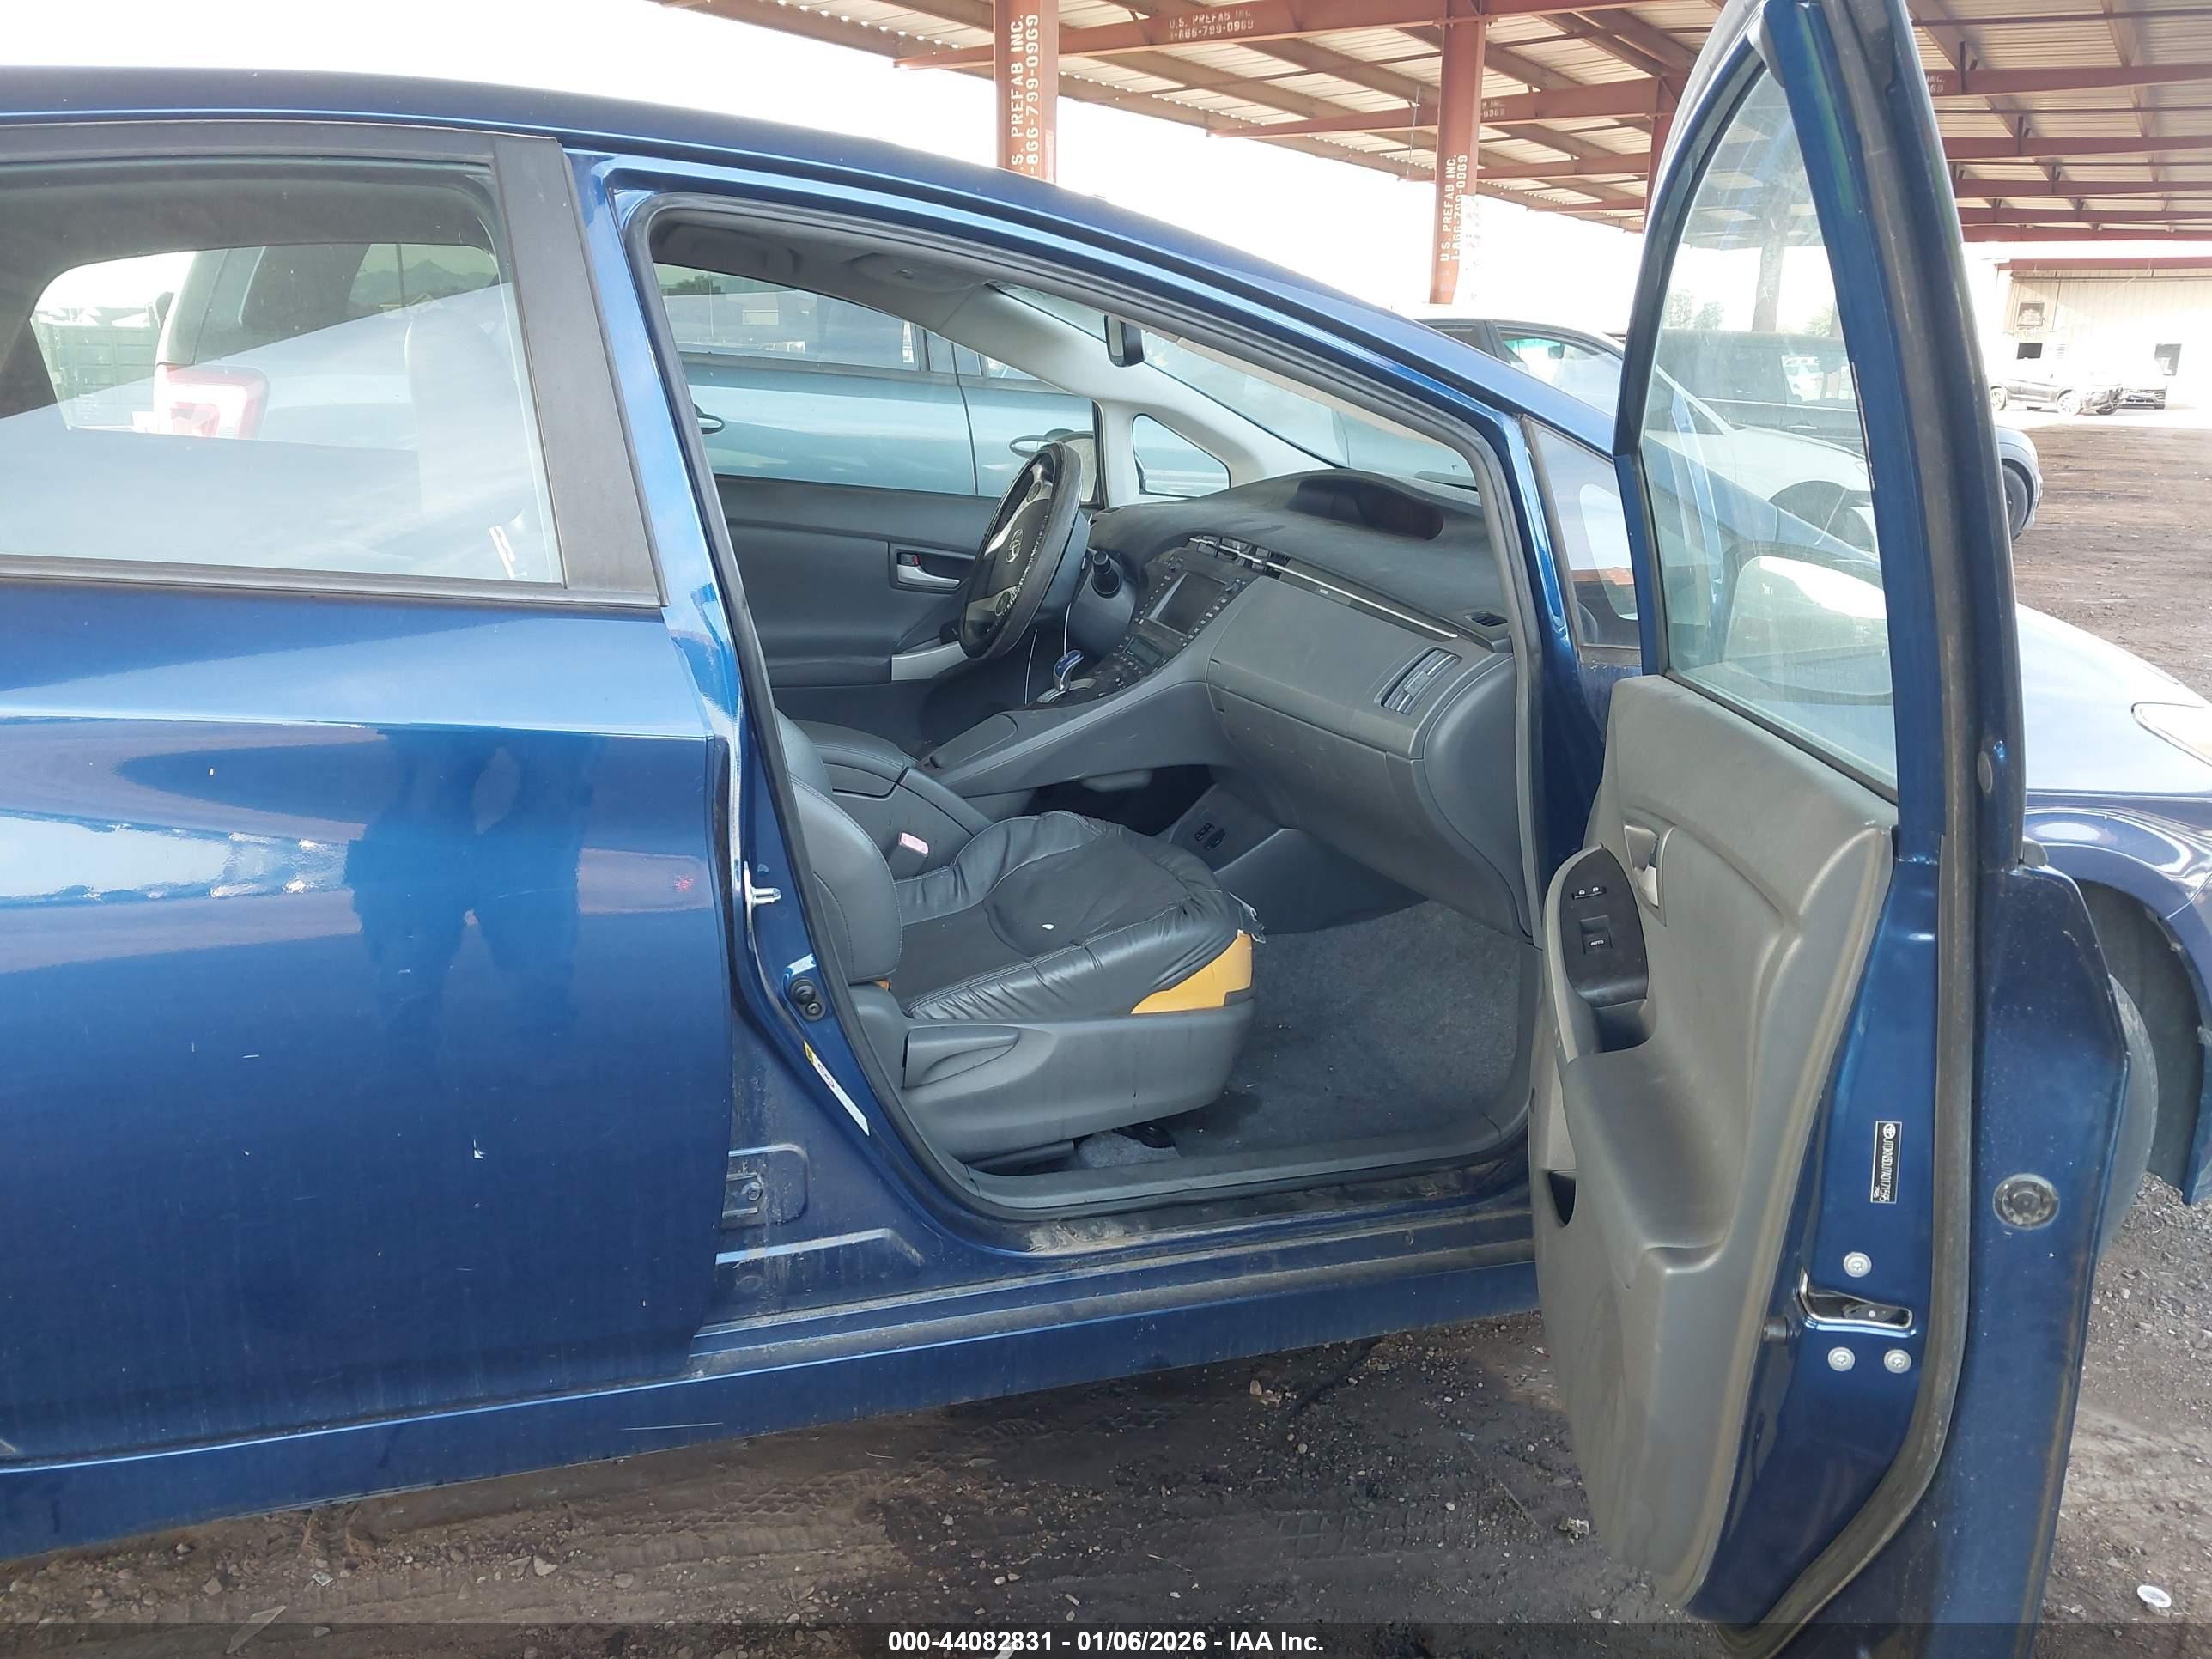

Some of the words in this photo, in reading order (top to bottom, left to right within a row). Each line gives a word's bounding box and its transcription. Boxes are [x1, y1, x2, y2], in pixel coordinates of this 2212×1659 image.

[1010, 14, 1024, 52] INC.
[1169, 17, 1188, 29] U.S.
[1192, 12, 1231, 25] PREFAB
[1010, 62, 1024, 138] PREFAB
[1025, 14, 1040, 179] -866-799-0969
[1445, 155, 1458, 179] INC.
[1443, 184, 1455, 232] PREFAB
[1440, 238, 1452, 262] U.S.
